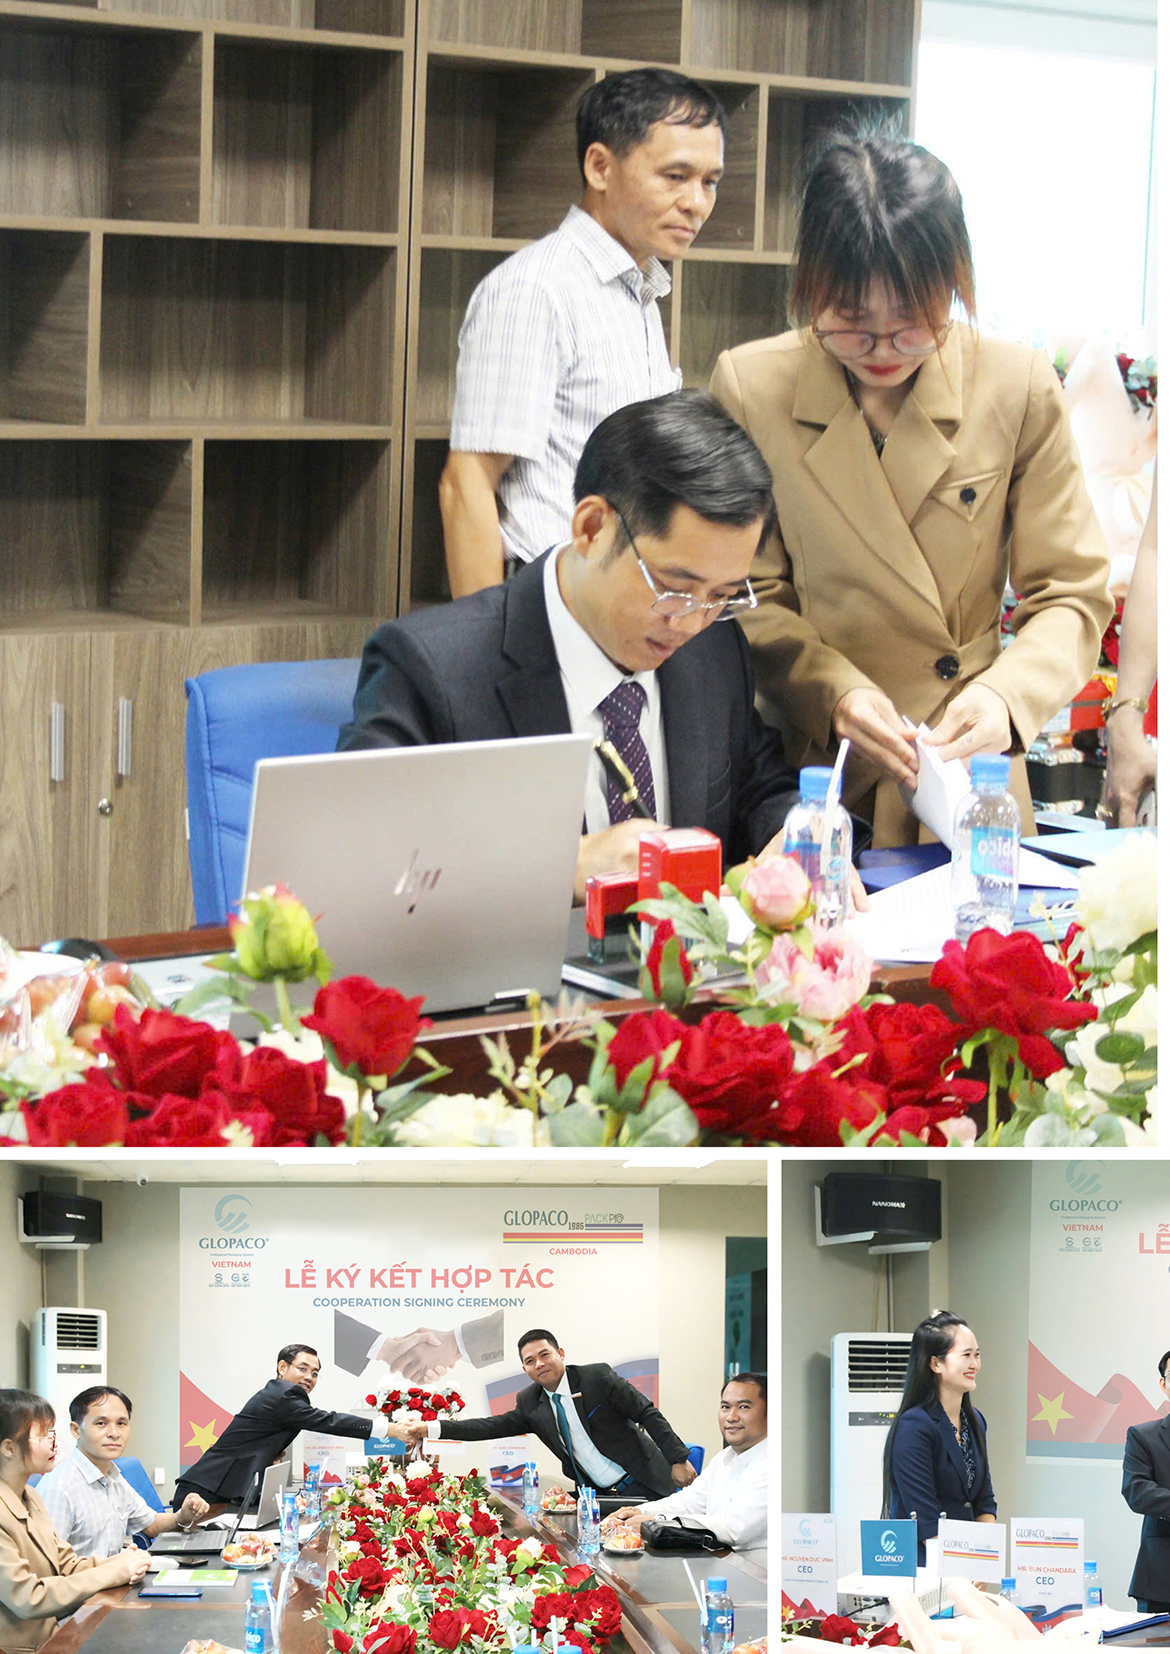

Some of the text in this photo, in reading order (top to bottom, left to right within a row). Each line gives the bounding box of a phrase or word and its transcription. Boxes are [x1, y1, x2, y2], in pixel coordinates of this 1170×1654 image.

[504, 1210, 568, 1226] GLOPACO
[568, 1222, 584, 1230] 1986
[285, 1259, 554, 1293] LỄ KÝ KẾT HỢP TÁC
[313, 1298, 526, 1307] COOPERATION SIGNING CEREMONY
[1016, 1528, 1045, 1538] GLOPACO
[943, 1539, 969, 1549] GLOPACO
[797, 1565, 813, 1573] CEO
[1036, 1577, 1055, 1585] CEO
